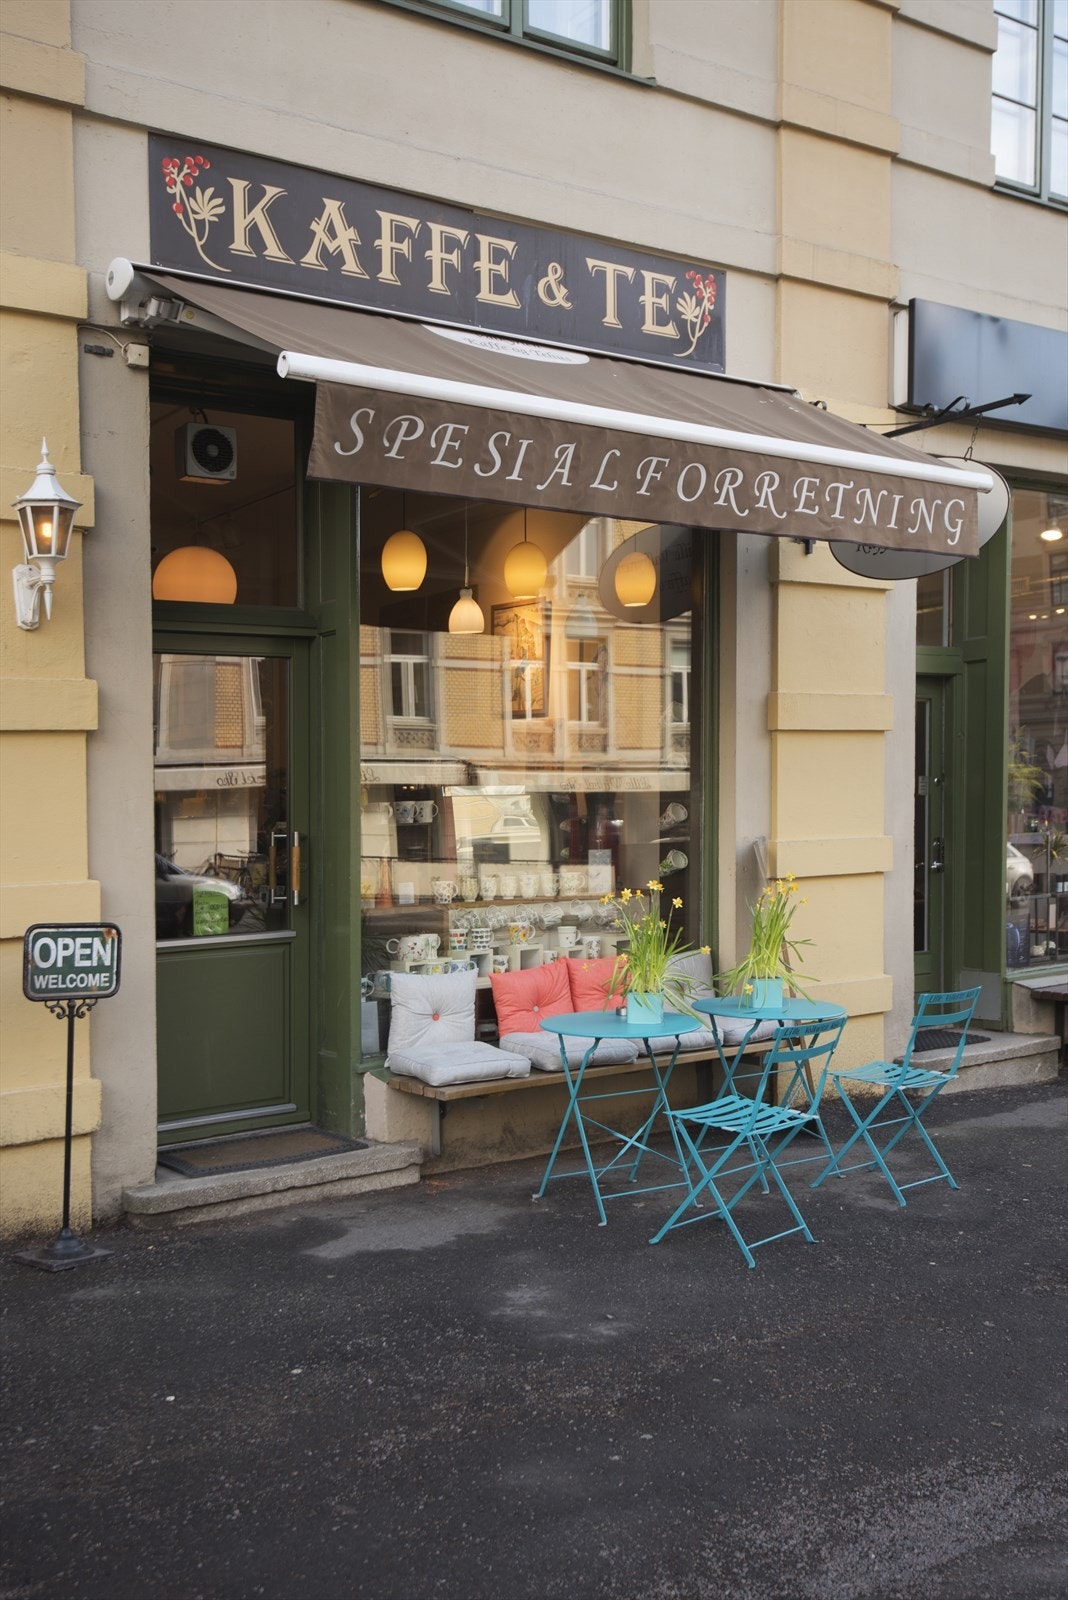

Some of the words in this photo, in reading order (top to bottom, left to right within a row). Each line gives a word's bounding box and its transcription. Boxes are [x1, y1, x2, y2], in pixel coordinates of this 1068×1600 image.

[227, 177, 521, 309] KAFFE
[538, 262, 573, 309] &
[585, 257, 681, 340] TE
[33, 937, 111, 968] OPEN
[34, 973, 110, 989] WELCOME
